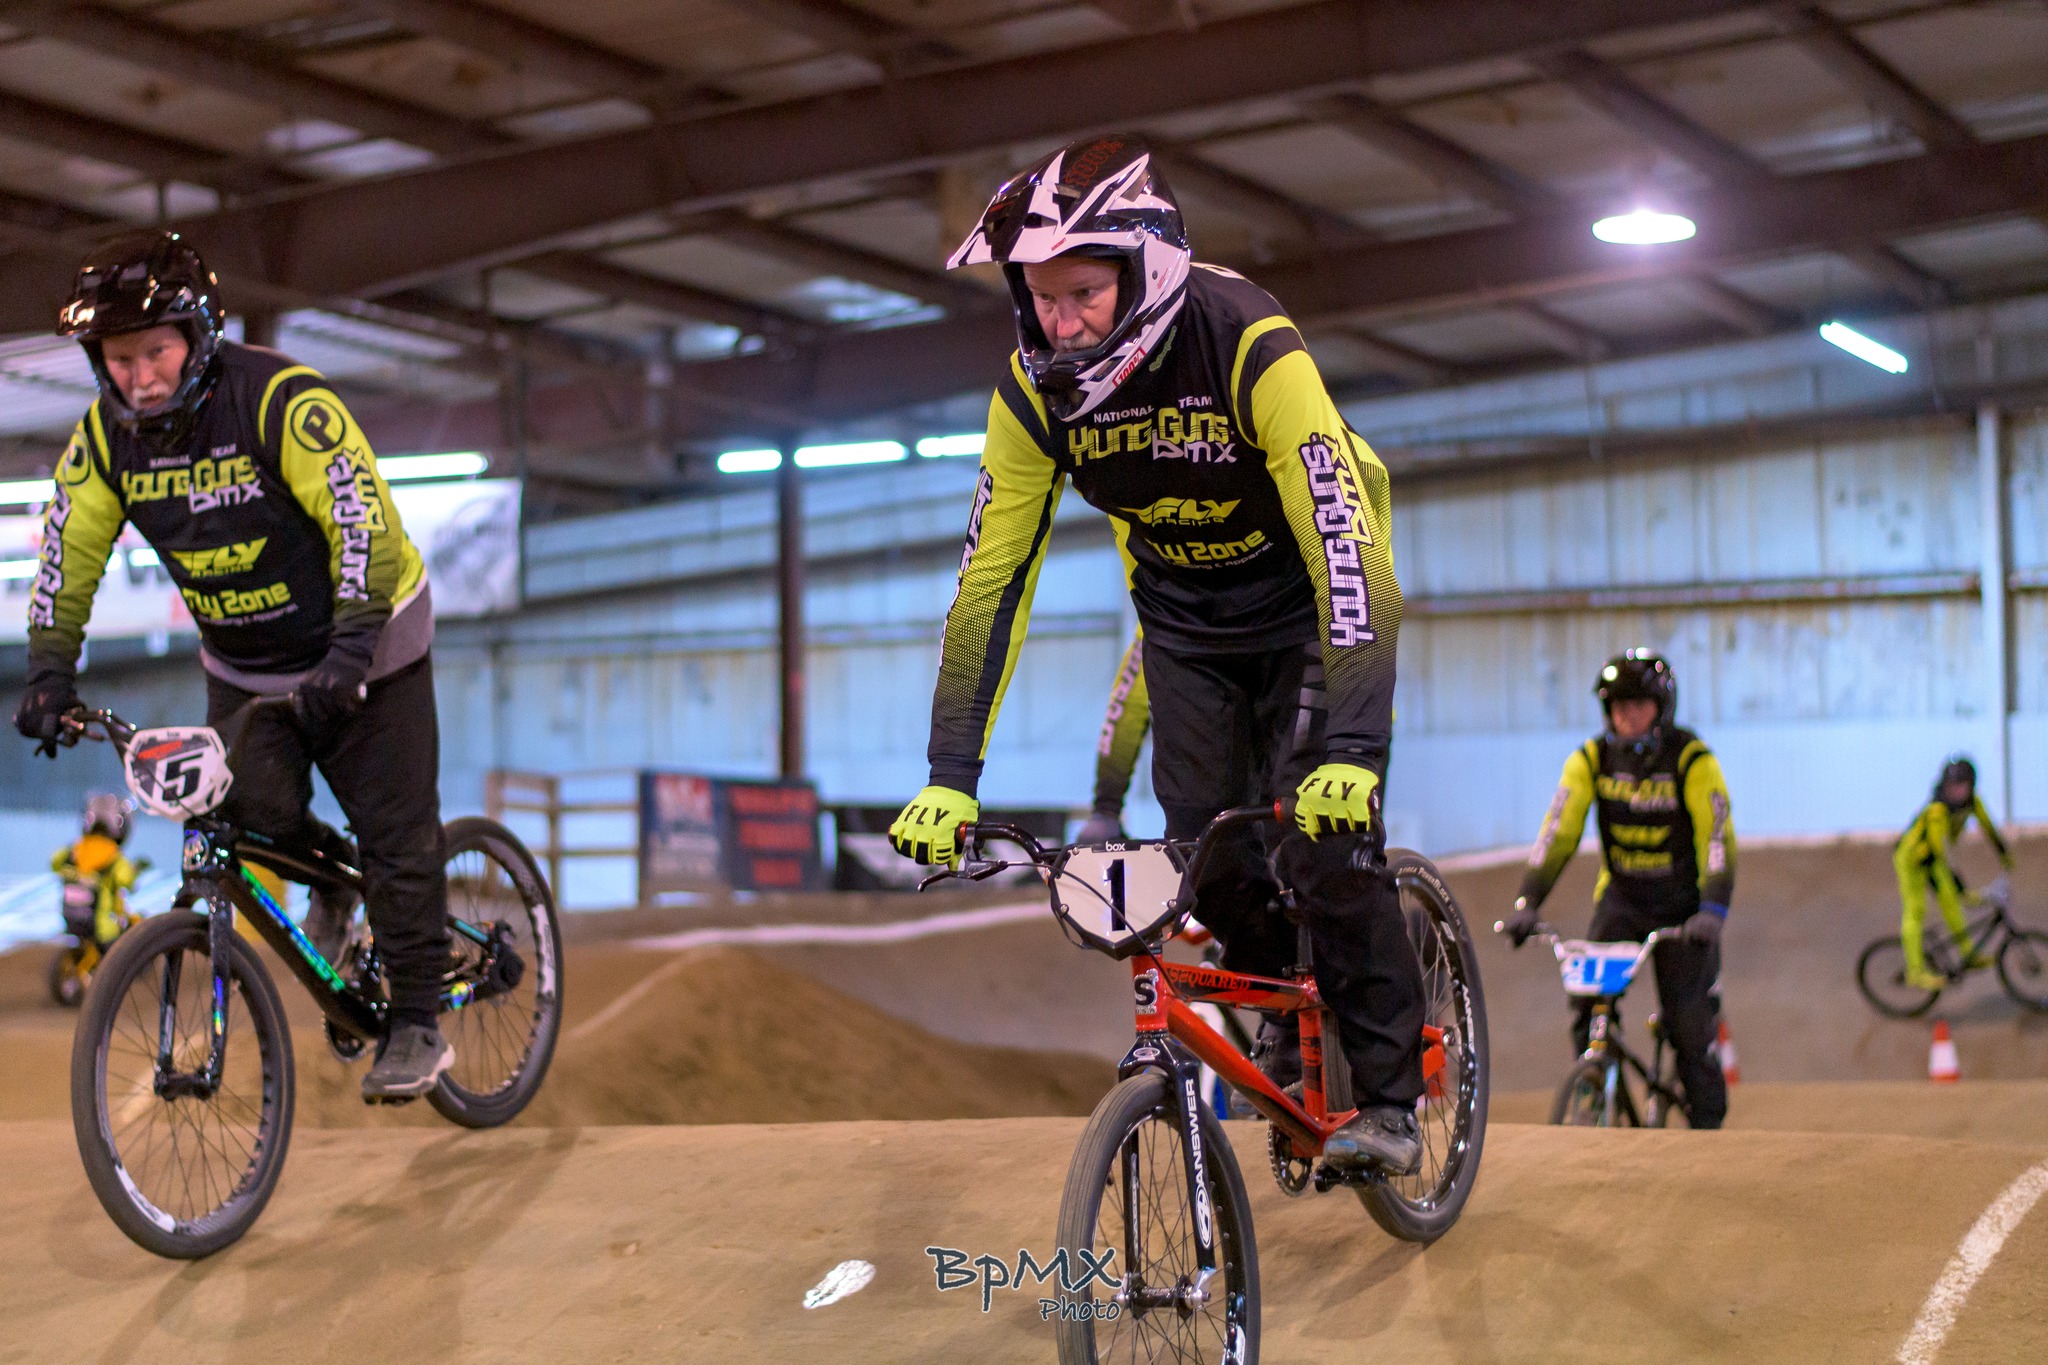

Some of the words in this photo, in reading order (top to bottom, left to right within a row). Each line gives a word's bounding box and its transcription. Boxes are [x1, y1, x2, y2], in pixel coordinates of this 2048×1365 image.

[1118, 352, 1144, 382] 100%
[1094, 405, 1154, 423] NATIONAL
[1178, 396, 1212, 409] TEAM
[1130, 497, 1242, 523] FLY
[162, 751, 205, 802] 5
[1302, 777, 1357, 801] FLY
[903, 804, 950, 826] FLY
[1105, 841, 1126, 852] box
[1104, 858, 1126, 931] 1
[1184, 1078, 1206, 1189] ANSWER
